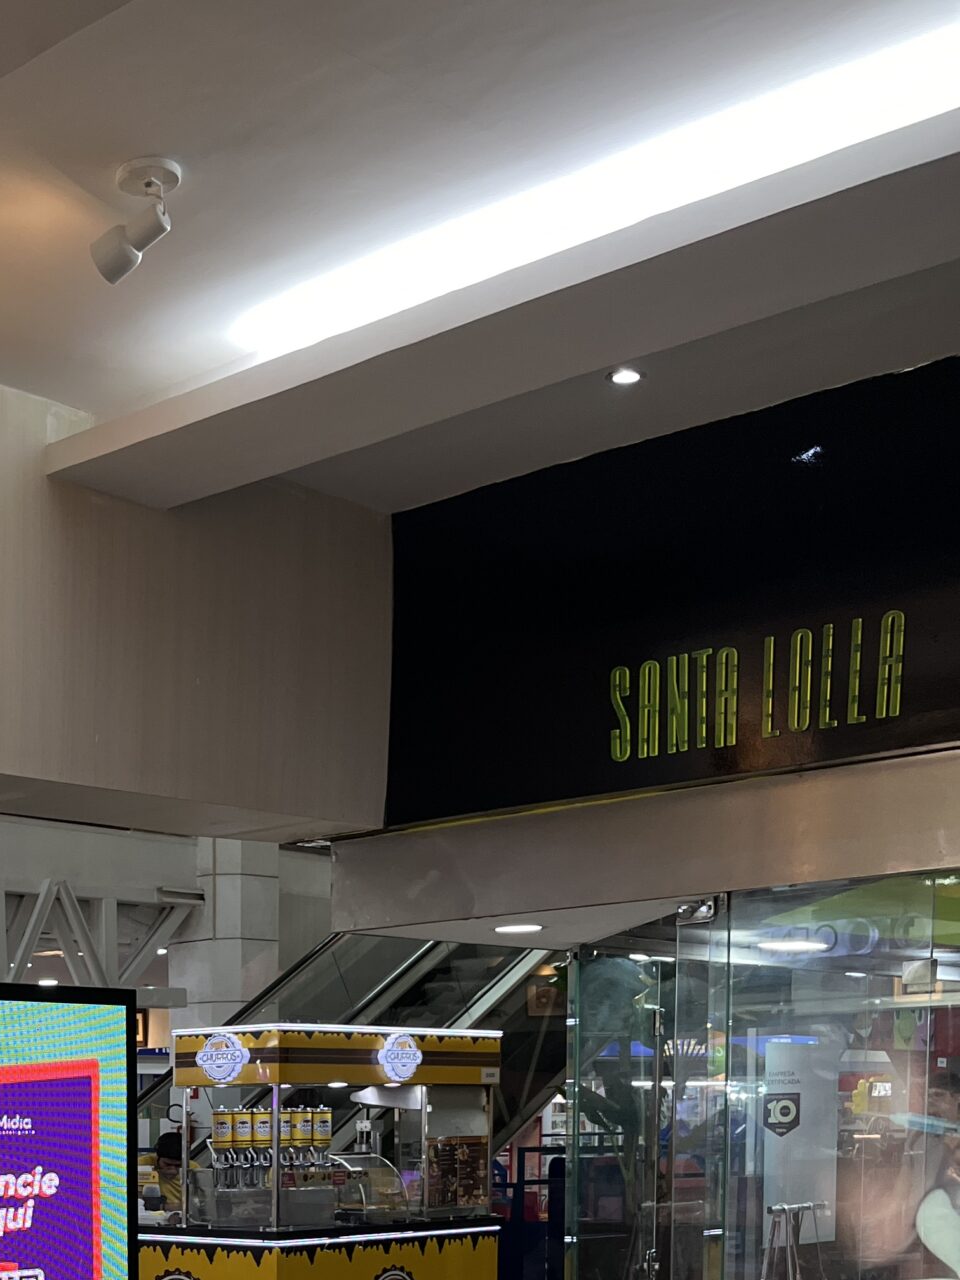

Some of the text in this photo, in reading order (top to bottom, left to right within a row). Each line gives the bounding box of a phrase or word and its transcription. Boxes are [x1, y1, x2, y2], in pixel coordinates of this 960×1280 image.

[610, 609, 905, 762] SANTA LOLLA
[202, 1051, 237, 1063] CHURROS
[767, 1099, 797, 1124] 10
